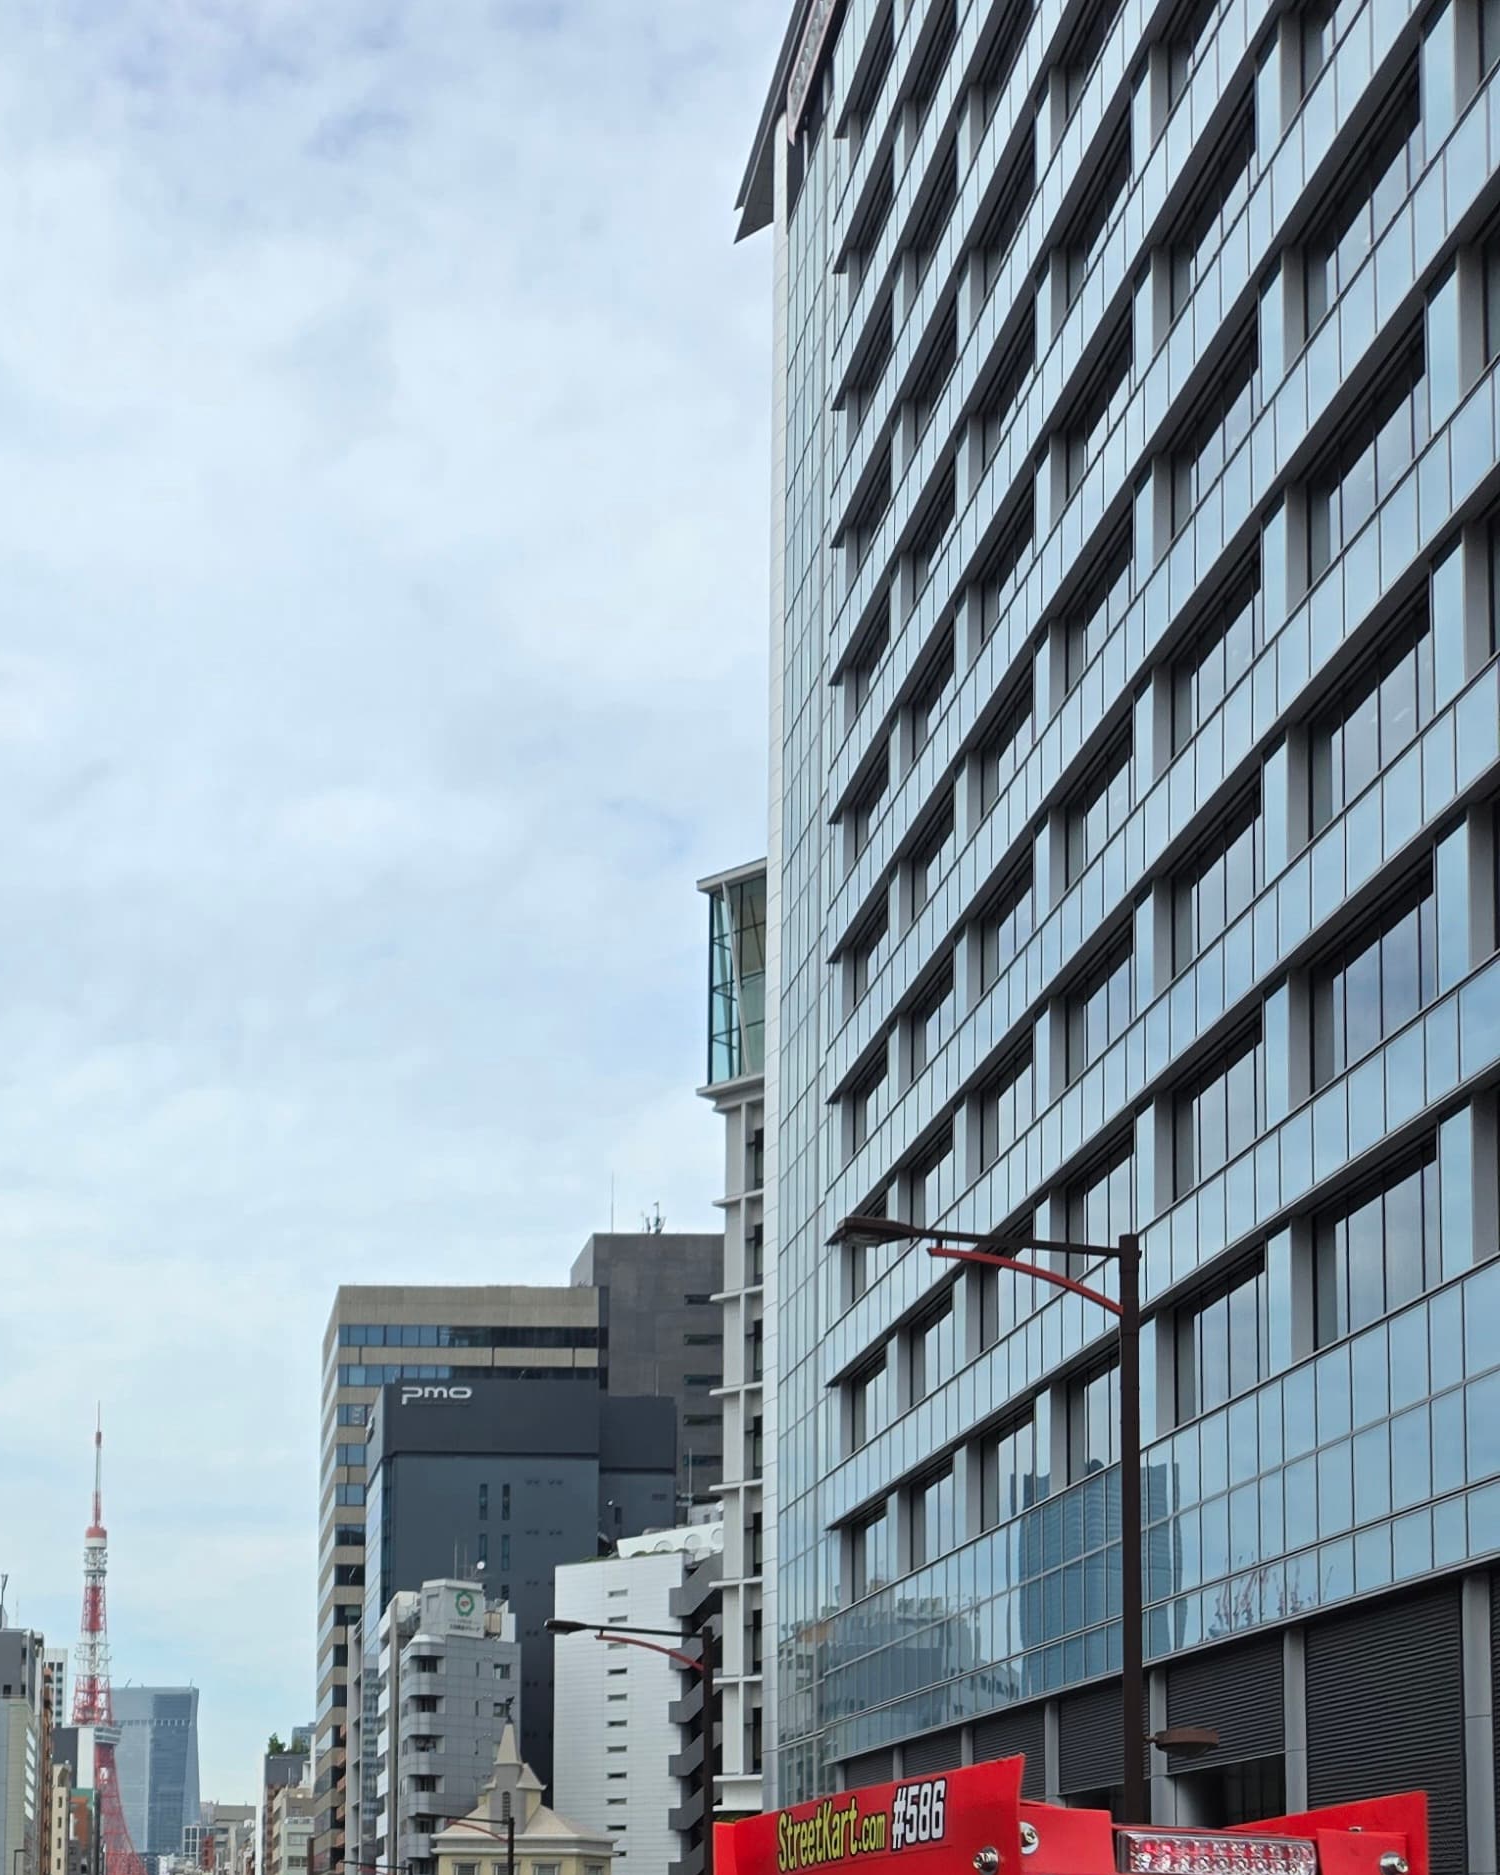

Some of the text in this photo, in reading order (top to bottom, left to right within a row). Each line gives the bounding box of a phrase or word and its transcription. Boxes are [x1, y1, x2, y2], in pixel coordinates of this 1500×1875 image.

[401, 1387, 472, 1405] pmo
[778, 1779, 946, 1872] StreetKart.com #586
